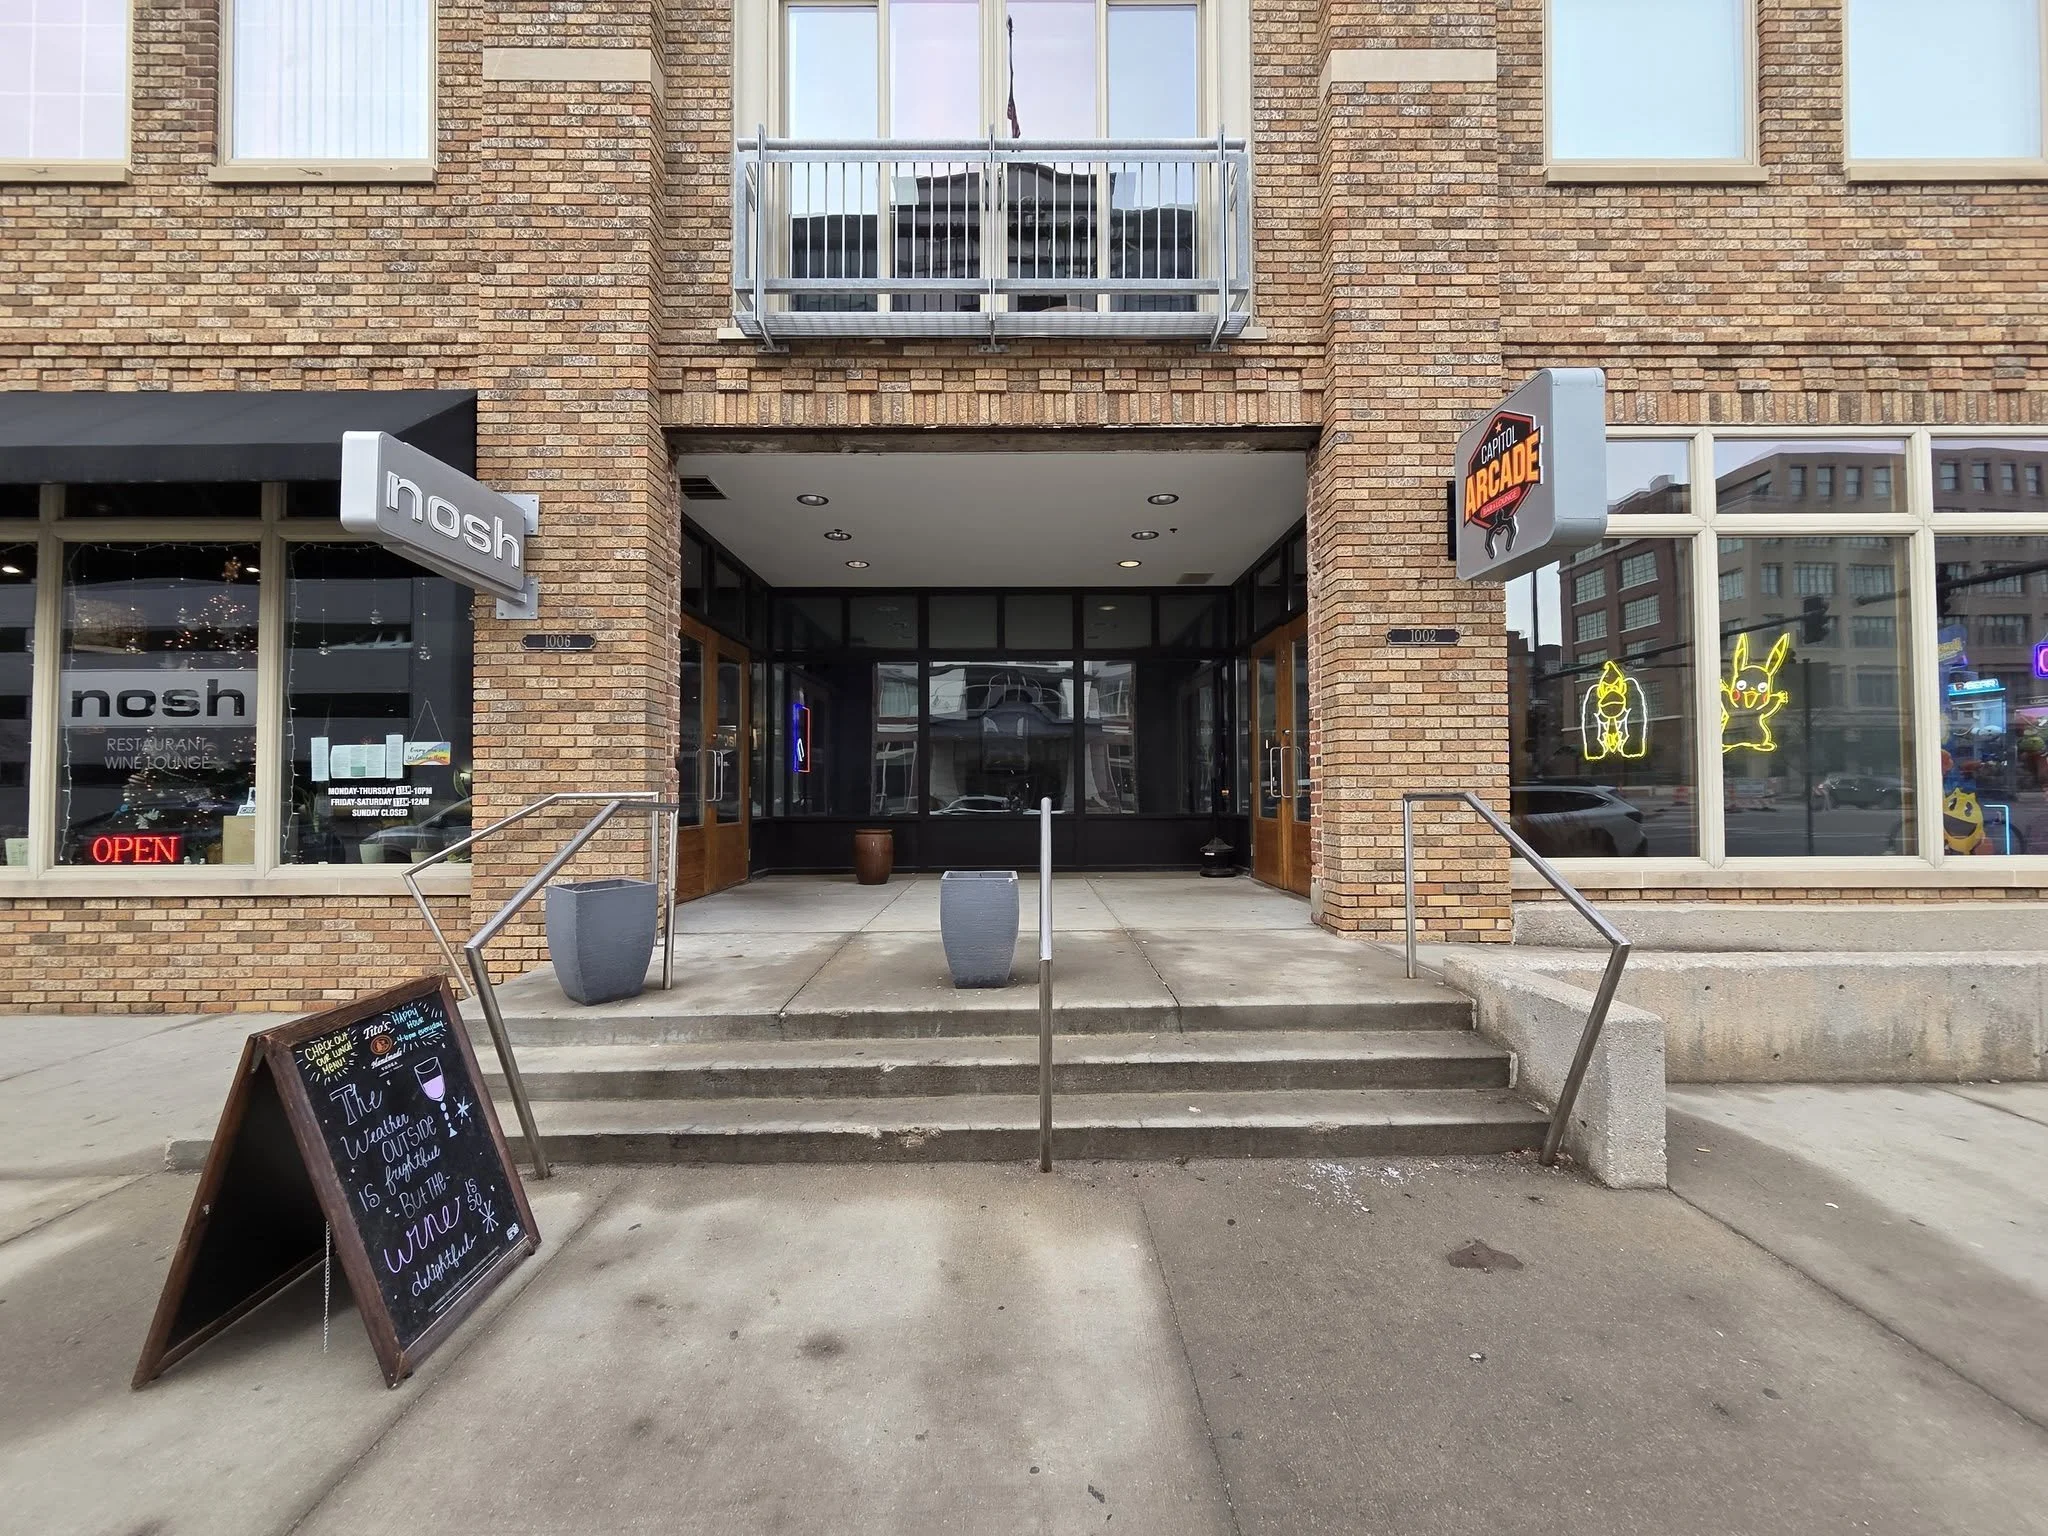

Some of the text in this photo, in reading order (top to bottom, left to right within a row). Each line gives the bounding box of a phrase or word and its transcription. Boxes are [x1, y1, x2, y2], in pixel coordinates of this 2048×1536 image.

[1481, 425, 1518, 464] CAPITOL
[1464, 430, 1539, 522] ARCADE
[386, 470, 520, 570] nosh
[545, 635, 571, 648] 1006
[1410, 629, 1436, 642] 1002
[71, 678, 245, 718] nosh
[106, 737, 208, 752] RESTAURANT
[104, 756, 212, 770] WINE LOUNGE
[328, 787, 395, 795] MONDAY-THURSDAY
[331, 798, 392, 806] FRIDAY-SATURDAY
[352, 809, 408, 817] SUNDAY CLOSED
[92, 837, 178, 863] OPEN
[316, 1052, 332, 1067] OUR
[329, 1083, 382, 1125] The
[340, 1113, 409, 1160] Weather
[385, 1145, 441, 1196] frightful
[411, 1232, 477, 1297] delightful
